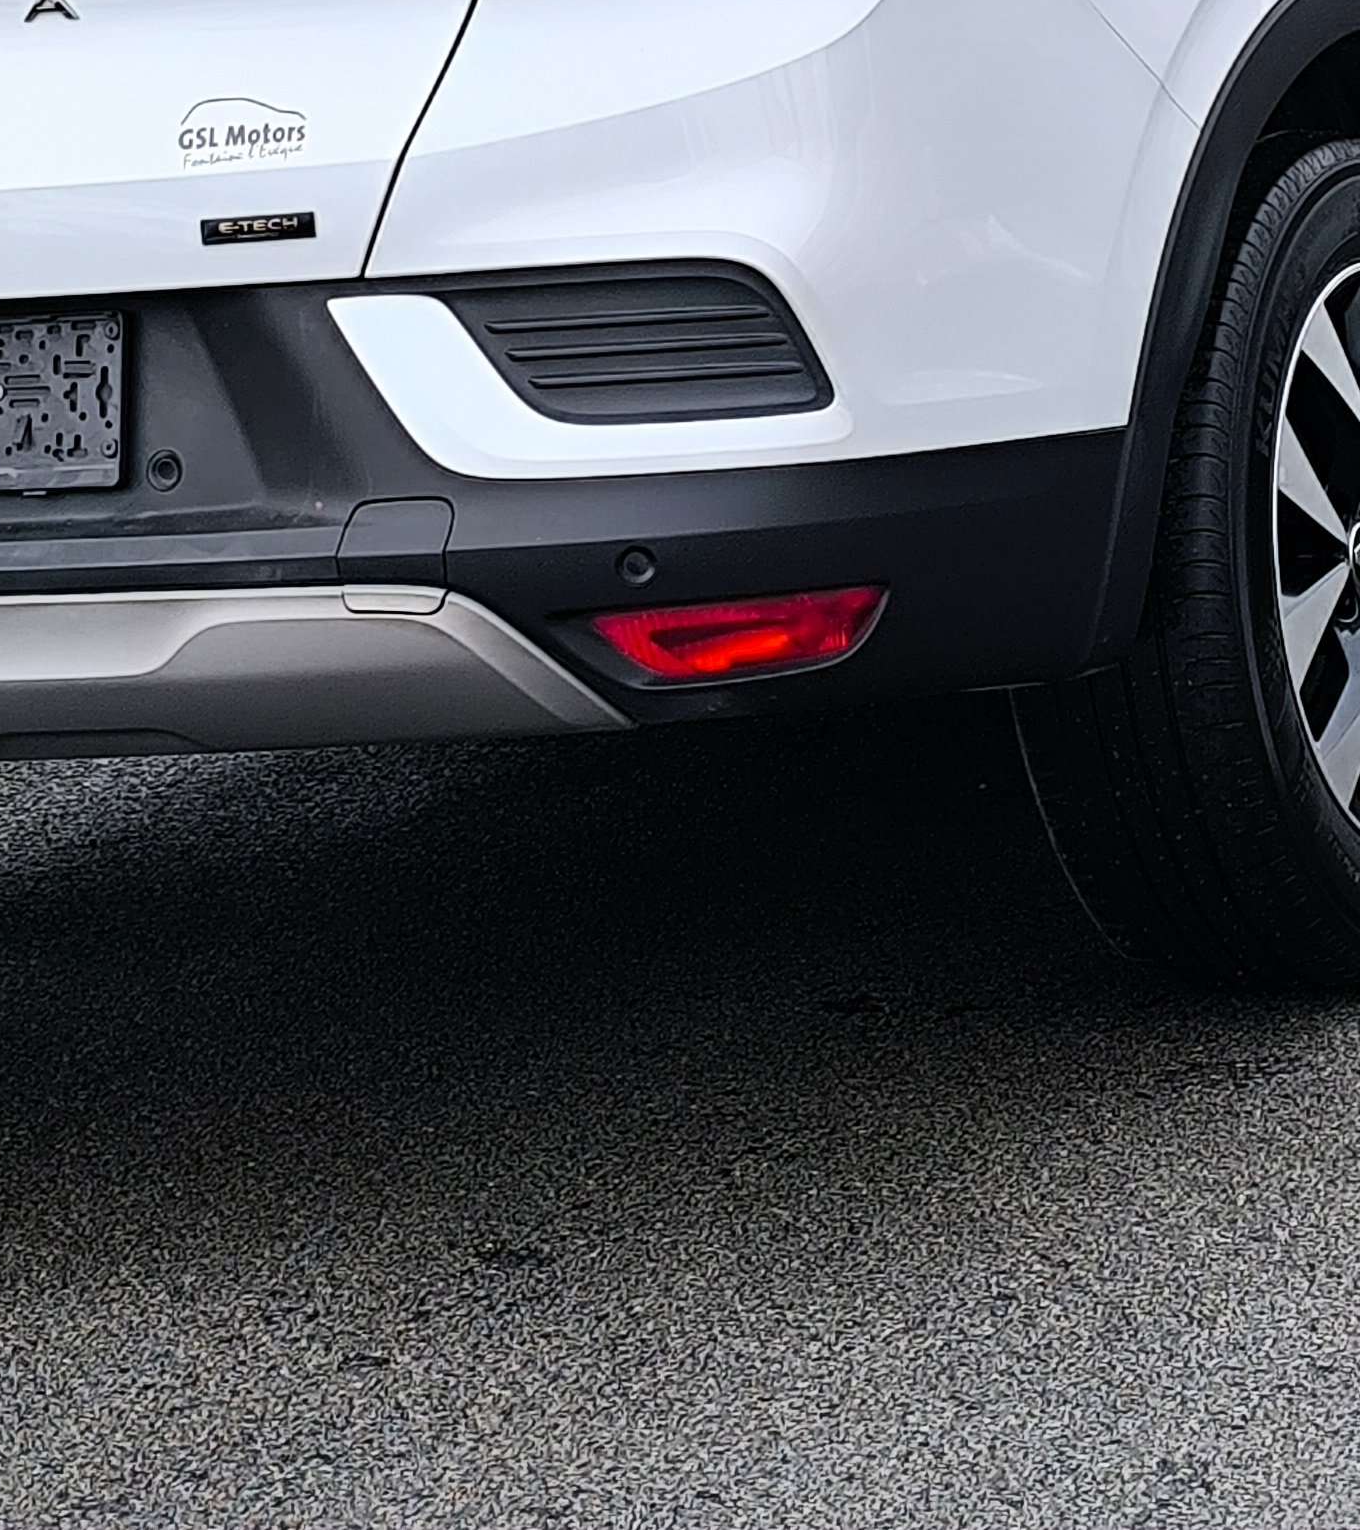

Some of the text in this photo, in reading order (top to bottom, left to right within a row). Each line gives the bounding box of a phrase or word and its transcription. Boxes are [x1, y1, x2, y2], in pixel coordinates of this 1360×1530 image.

[178, 123, 306, 150] GSL Motors
[218, 216, 298, 234] E-TECH
